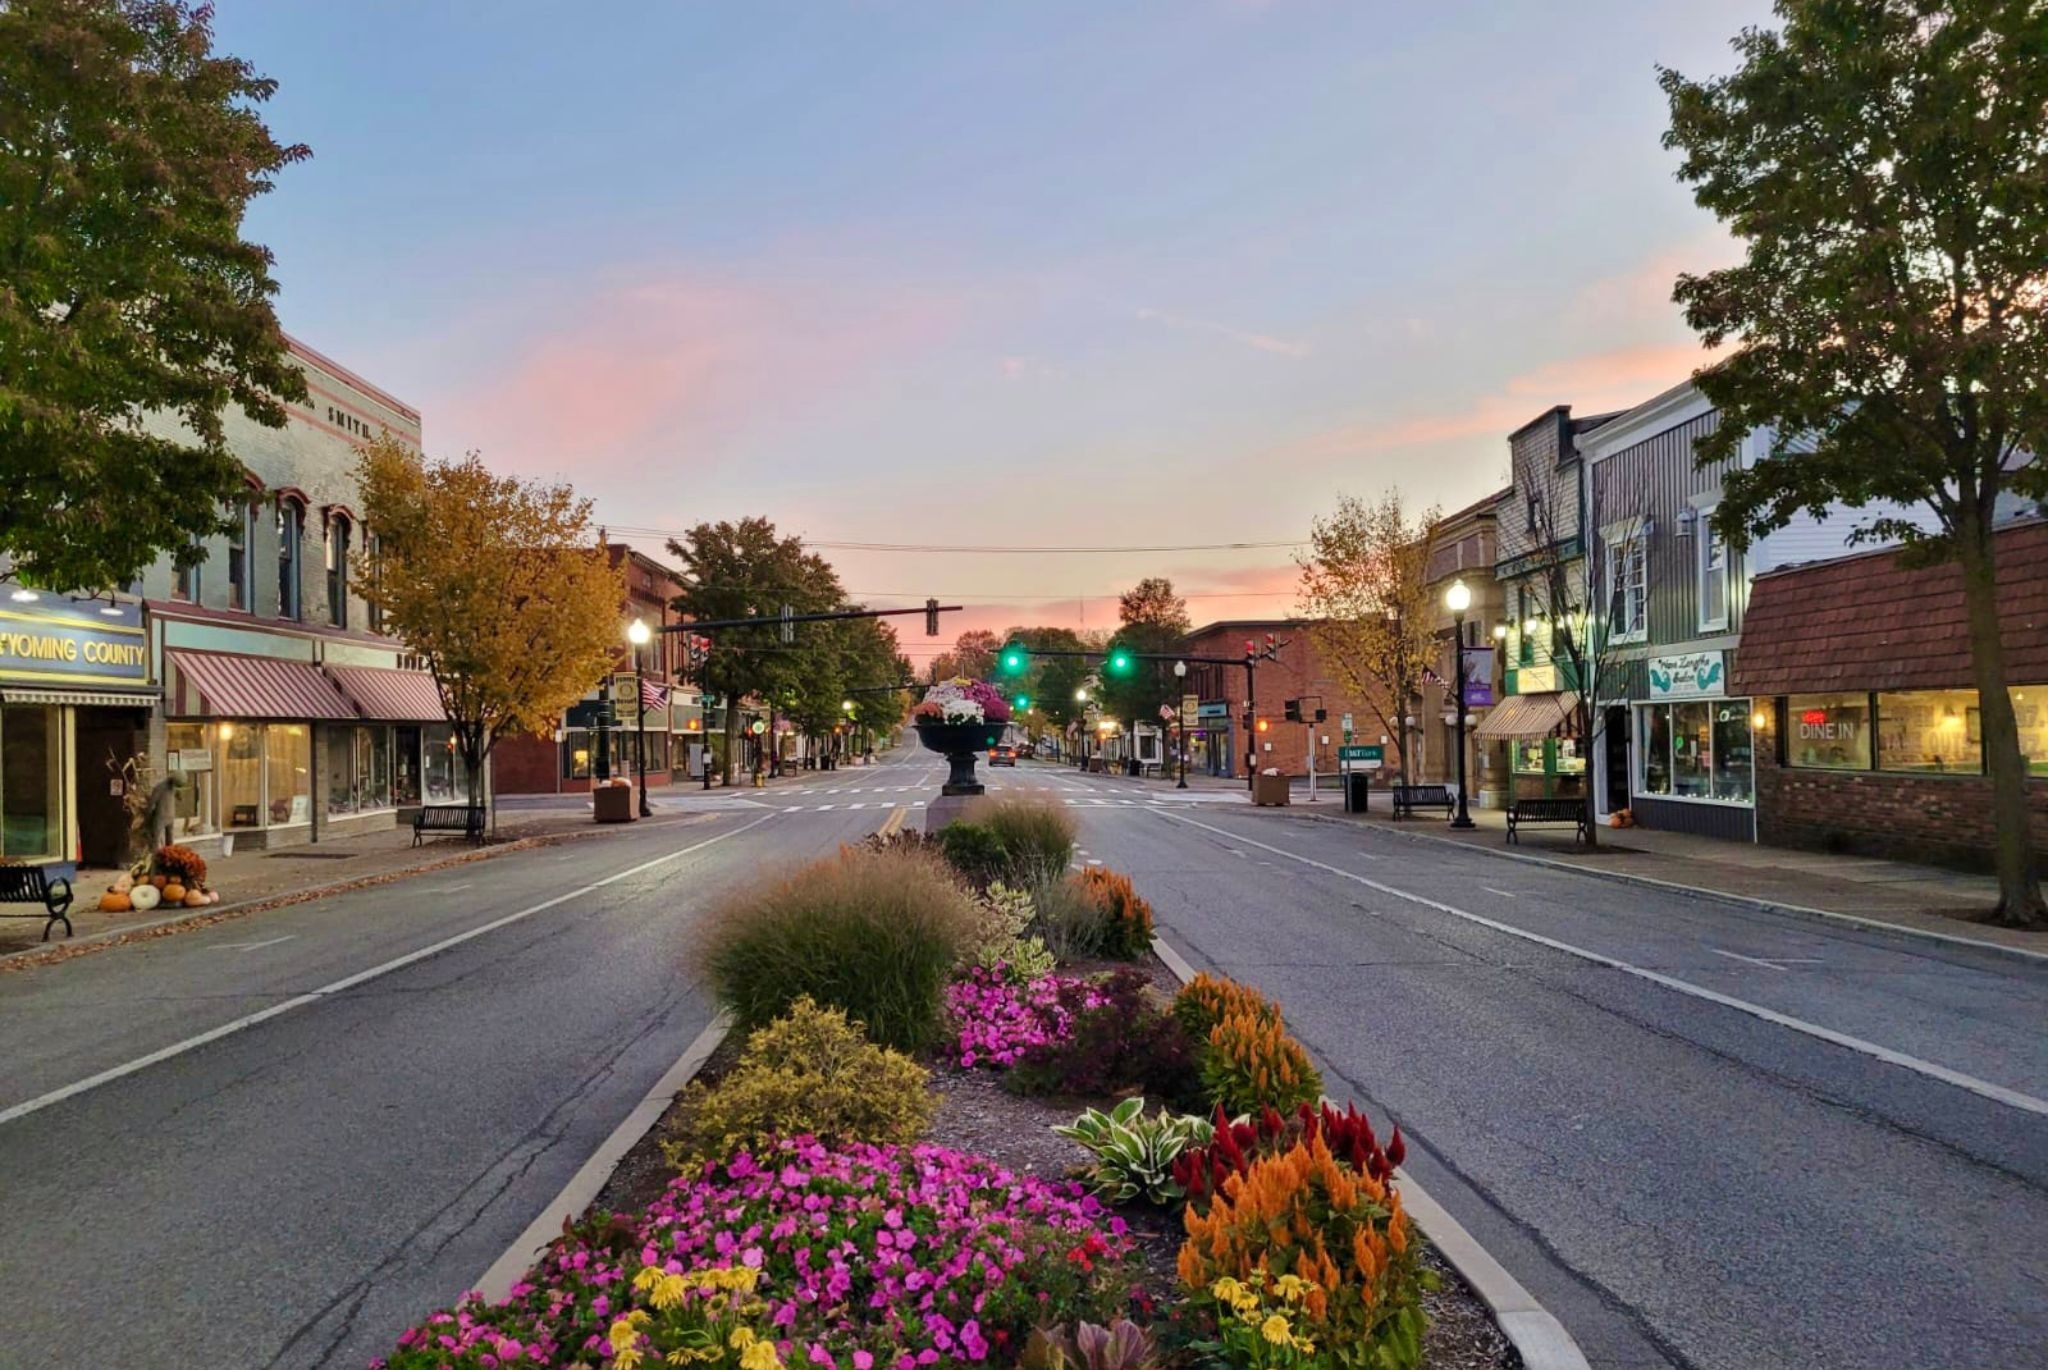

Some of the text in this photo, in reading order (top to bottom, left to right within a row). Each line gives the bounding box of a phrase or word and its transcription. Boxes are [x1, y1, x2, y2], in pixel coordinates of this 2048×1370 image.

[328, 406, 370, 440] SMITH
[83, 641, 144, 666] COUNTY
[1800, 721, 1854, 740] DINE IN
